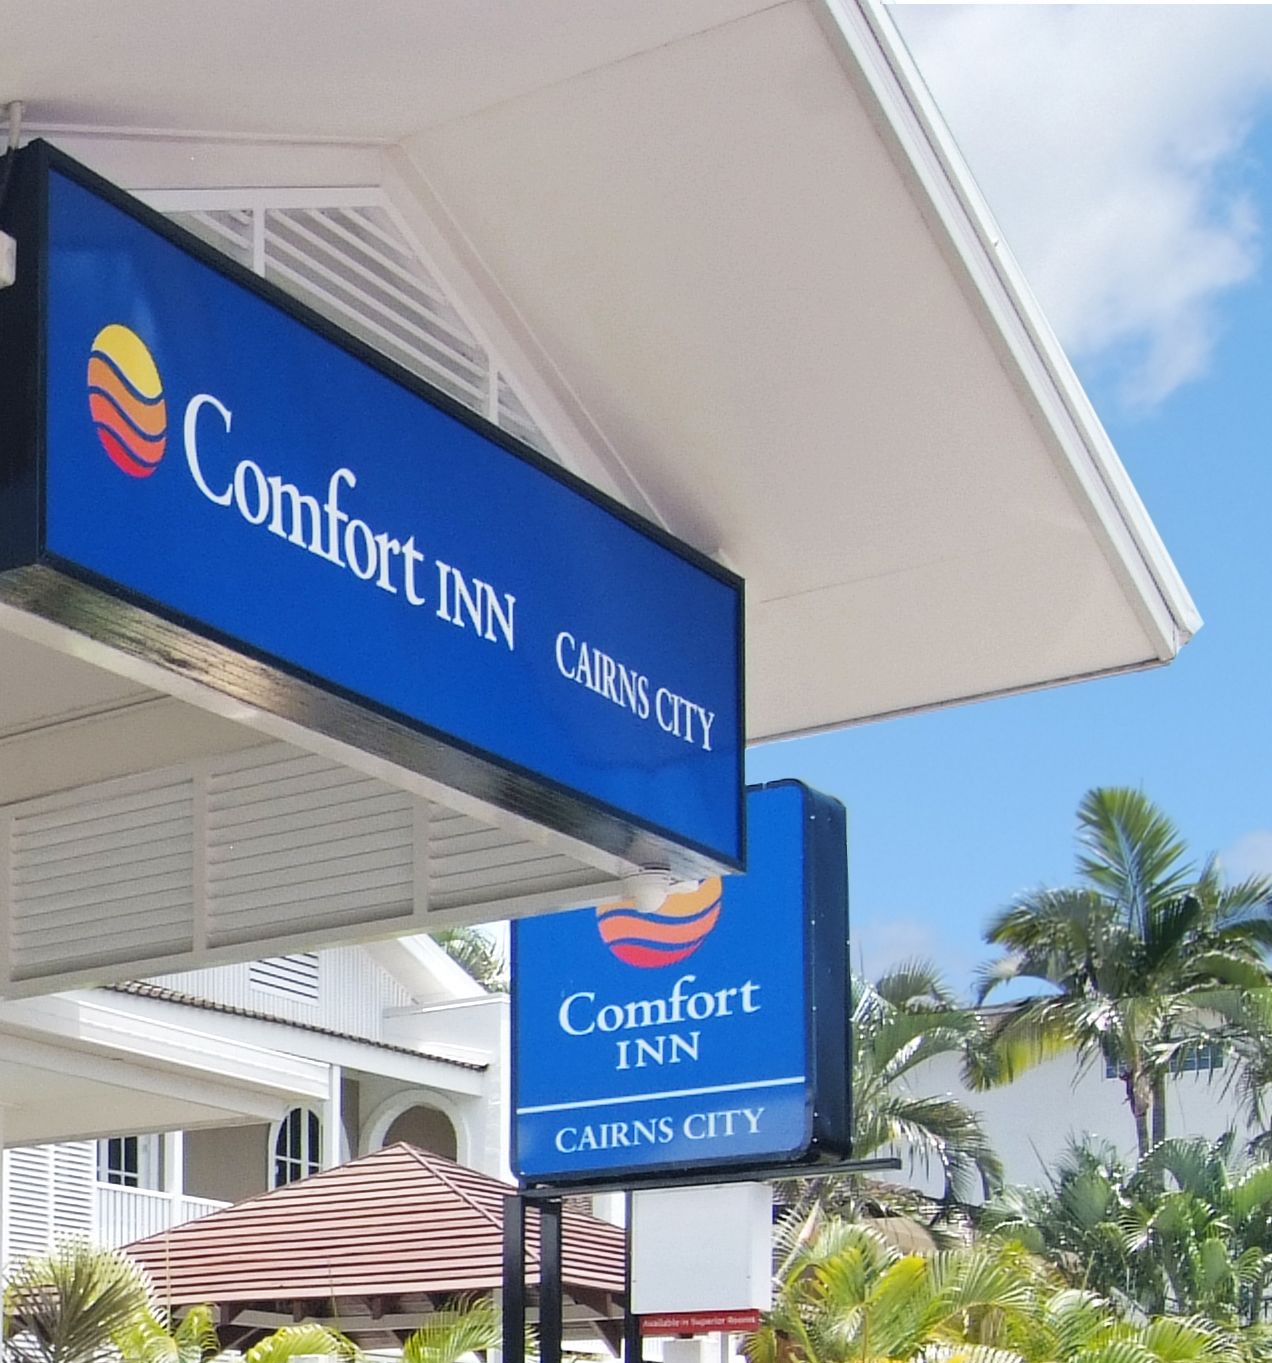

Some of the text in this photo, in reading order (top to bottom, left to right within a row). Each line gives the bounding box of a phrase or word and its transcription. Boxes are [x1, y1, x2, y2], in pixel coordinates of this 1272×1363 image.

[184, 393, 517, 651] Comfort INN
[555, 631, 715, 752] CAIRNS CITY
[558, 974, 761, 1036] Comfort
[616, 1031, 701, 1070] INN
[555, 1107, 766, 1154] CAIRNS CITY
